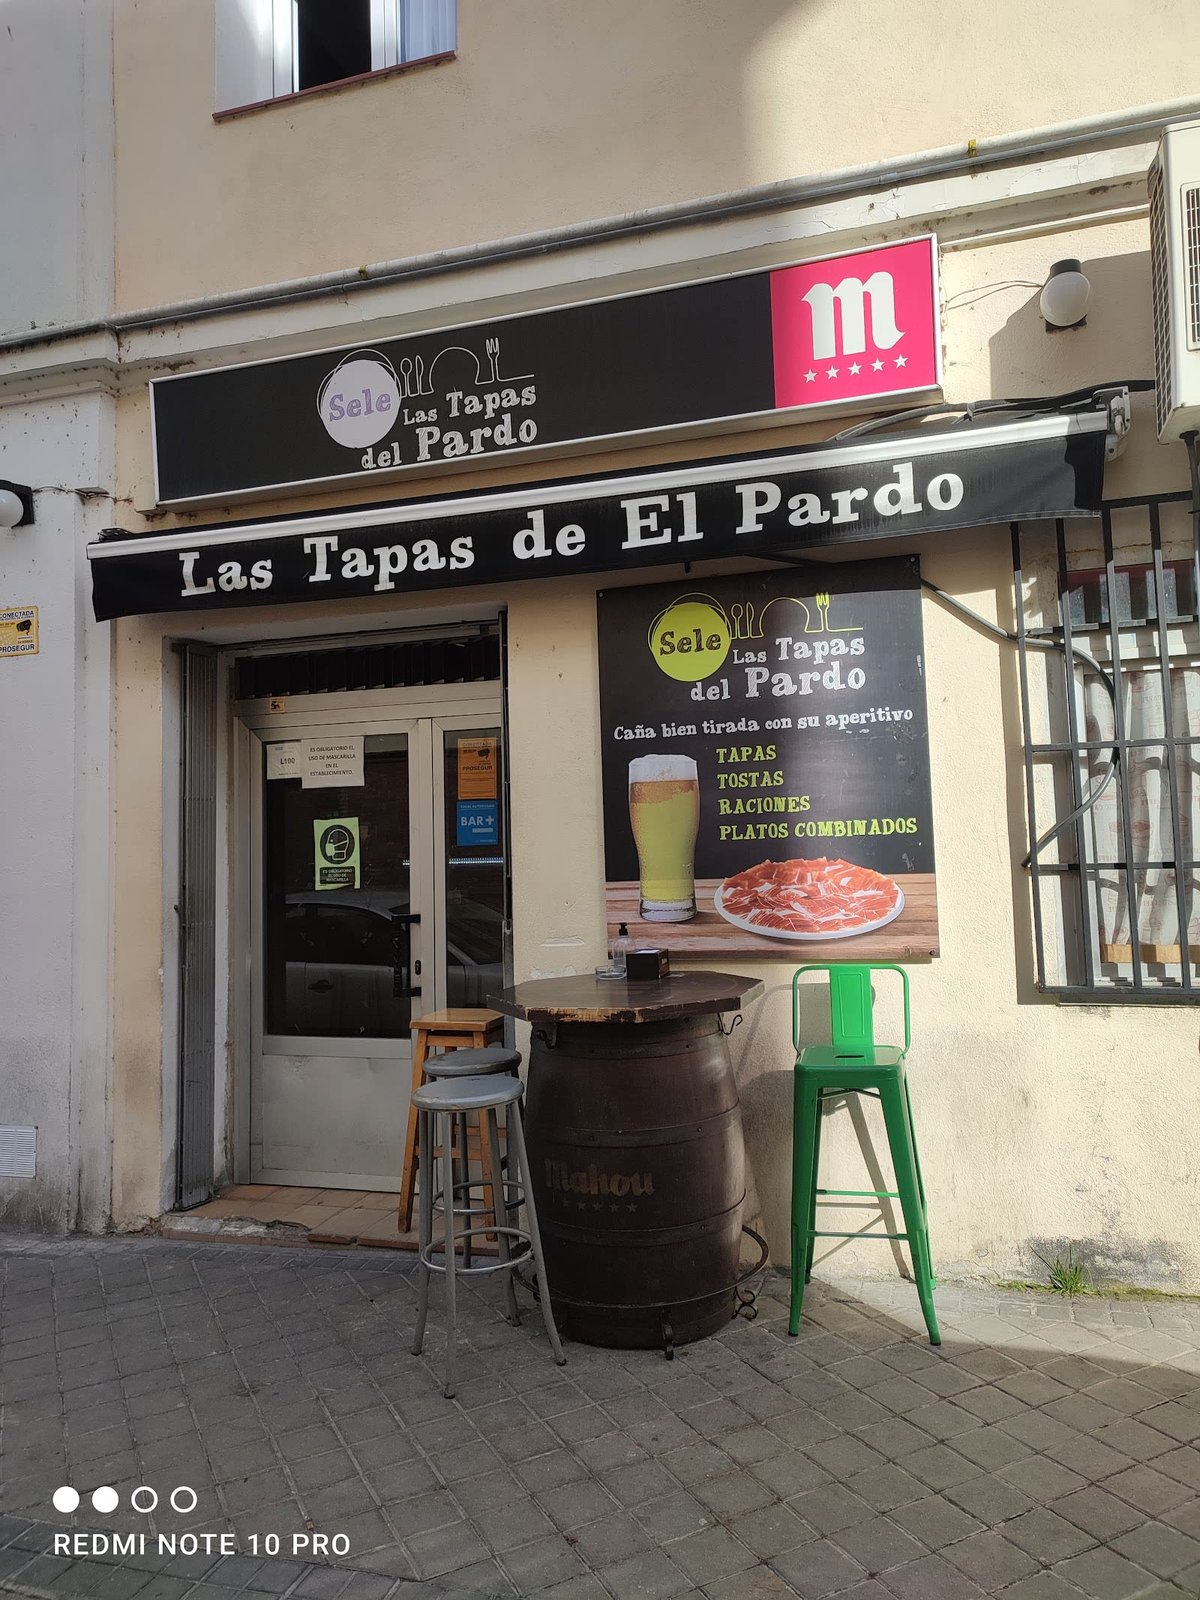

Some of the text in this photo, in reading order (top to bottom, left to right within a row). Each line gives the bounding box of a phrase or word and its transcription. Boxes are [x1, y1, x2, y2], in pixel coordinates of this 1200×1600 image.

[329, 388, 392, 422] Sele
[403, 385, 537, 426] Las Tapas
[361, 413, 538, 470] del Pardo
[179, 462, 965, 597] Las Tapas de El Pardo
[659, 628, 722, 657] Sele
[732, 636, 866, 666] Las Tapas
[690, 661, 866, 702] del Pardo
[614, 707, 914, 741] Caña bien tirada con su aperitivo
[716, 744, 776, 764] TAPAS
[717, 771, 784, 790] TOSTAS
[718, 796, 811, 816] RACIONES
[719, 818, 918, 842] PLATOS COMBINADOS
